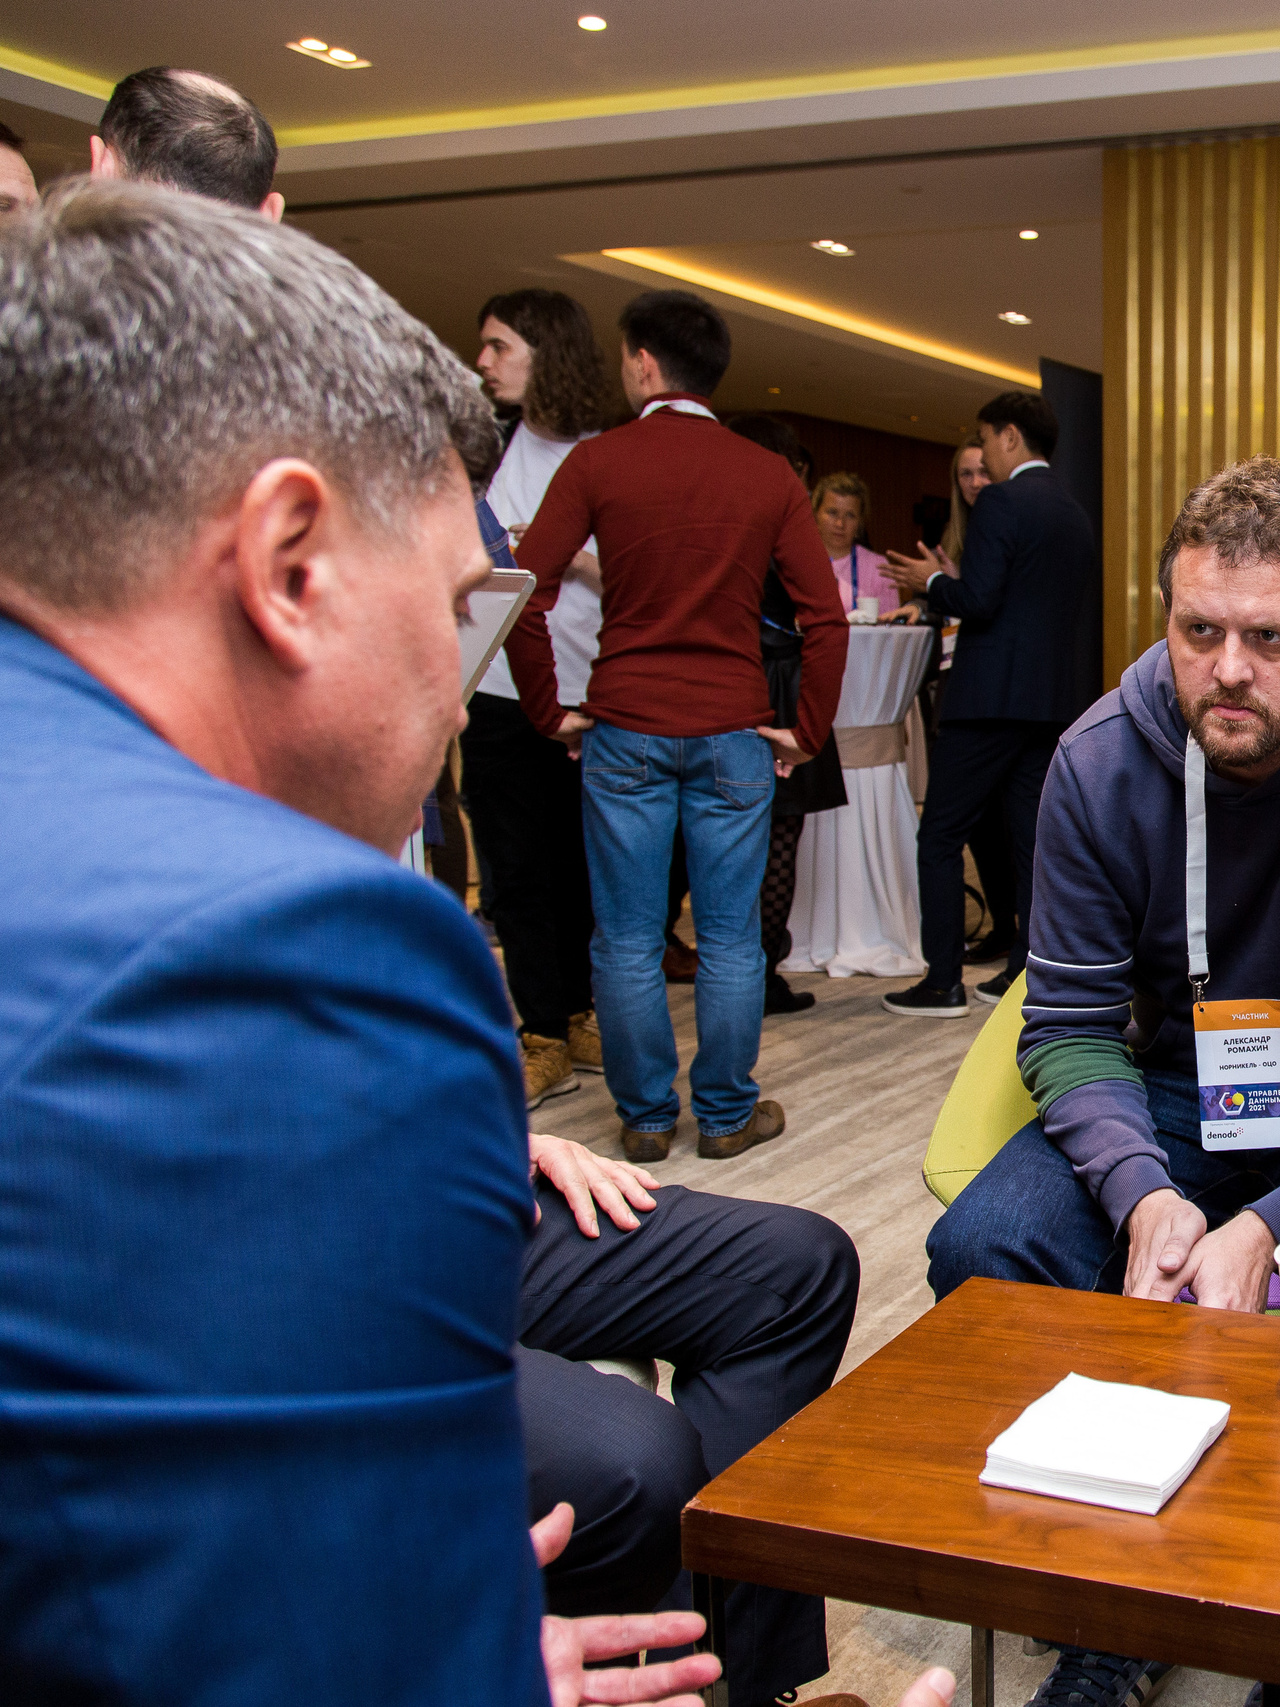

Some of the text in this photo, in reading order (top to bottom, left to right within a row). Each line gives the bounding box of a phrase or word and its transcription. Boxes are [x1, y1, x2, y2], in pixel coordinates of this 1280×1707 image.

[1231, 1012, 1269, 1021] УЧАСТНИК
[1223, 1035, 1271, 1046] АЛЕКСАНДР
[1227, 1044, 1269, 1054] РОМАХИН
[1219, 1063, 1257, 1071] НОРНИКЕЛЬ
[1248, 1104, 1266, 1112] 2021
[1206, 1130, 1238, 1139] denodo
